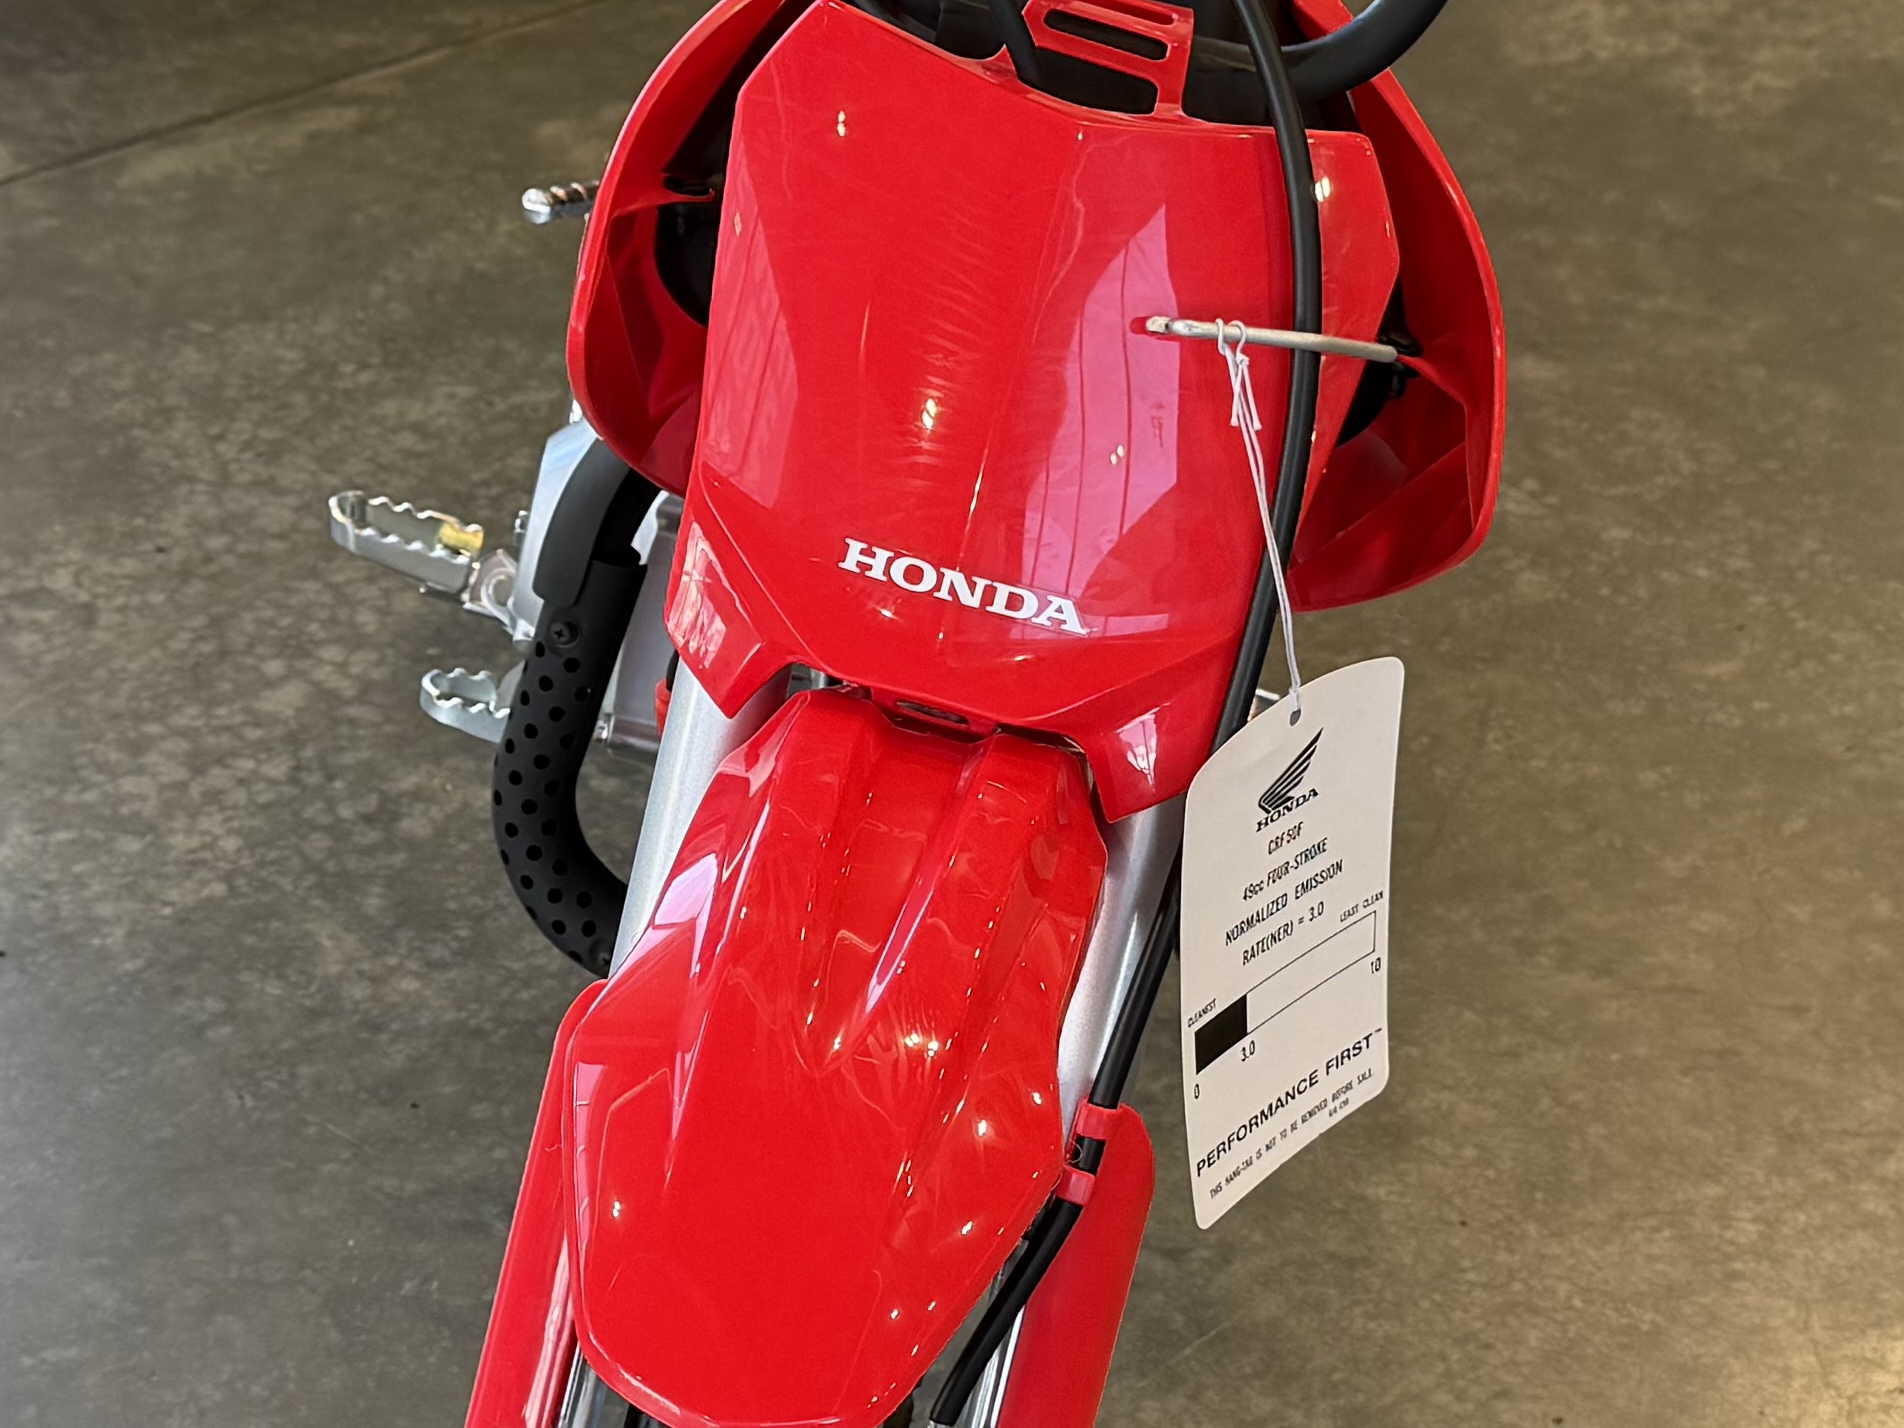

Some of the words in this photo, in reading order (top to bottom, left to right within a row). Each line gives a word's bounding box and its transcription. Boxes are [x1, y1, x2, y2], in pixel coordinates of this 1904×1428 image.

[838, 538, 1087, 634] HONDA
[1256, 788, 1319, 833] HONDA
[1266, 837, 1328, 887] FOUR-STROKE
[1225, 893, 1288, 946] NORMALIZED
[1295, 859, 1343, 900] EMISSION
[1309, 901, 1324, 922] 3.0
[1340, 904, 1359, 922] LEAST
[1371, 957, 1381, 974] 10
[1241, 1040, 1255, 1062] 3.0
[1194, 1083, 1200, 1100] 0
[1197, 1069, 1318, 1177] PERFORMANCE
[1325, 1033, 1372, 1076] FIRST
